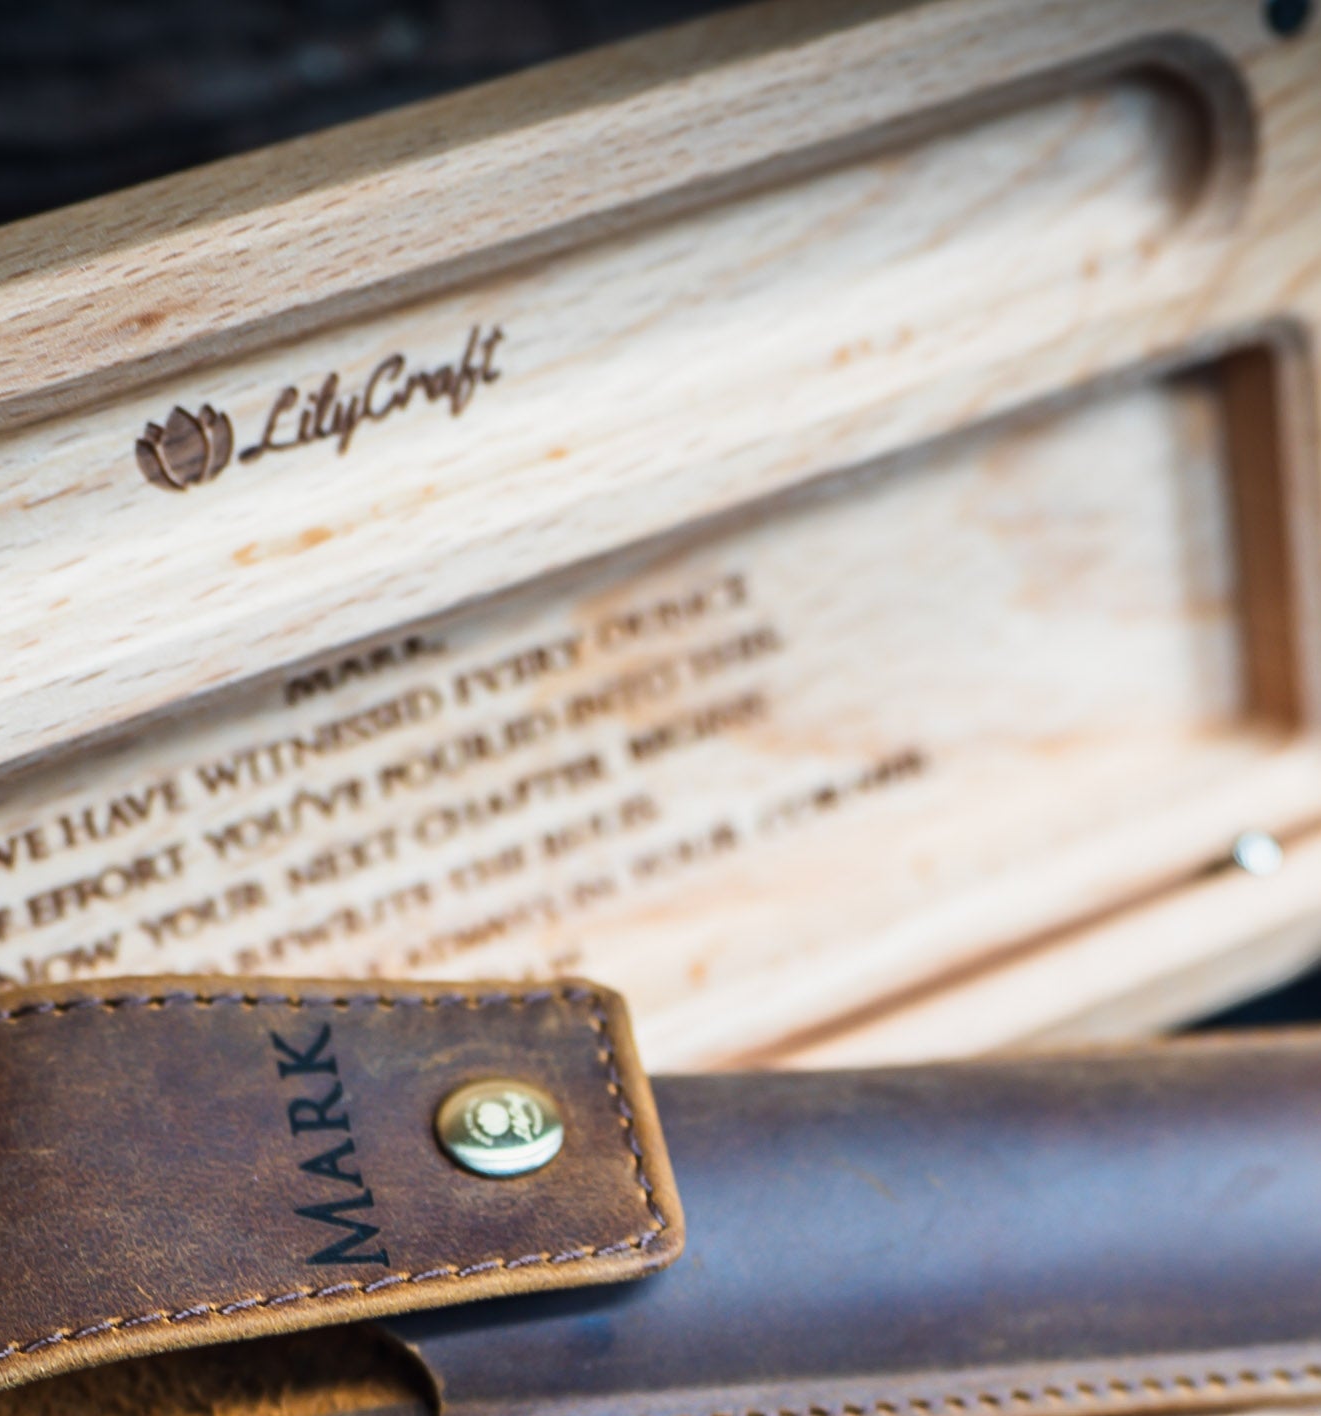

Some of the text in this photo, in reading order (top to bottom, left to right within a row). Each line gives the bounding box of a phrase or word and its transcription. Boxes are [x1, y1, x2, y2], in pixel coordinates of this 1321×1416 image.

[239, 324, 506, 463] LilyCraft
[25, 840, 186, 929] EFFORT
[379, 707, 558, 798] POURED
[57, 780, 189, 849] HAVE
[195, 685, 444, 796] WITNESSED
[453, 637, 585, 708] EVERY
[139, 878, 268, 950] YOUR
[285, 826, 400, 896] NEXT
[413, 752, 609, 852] CHAPTER
[270, 1022, 390, 1268] MARK
